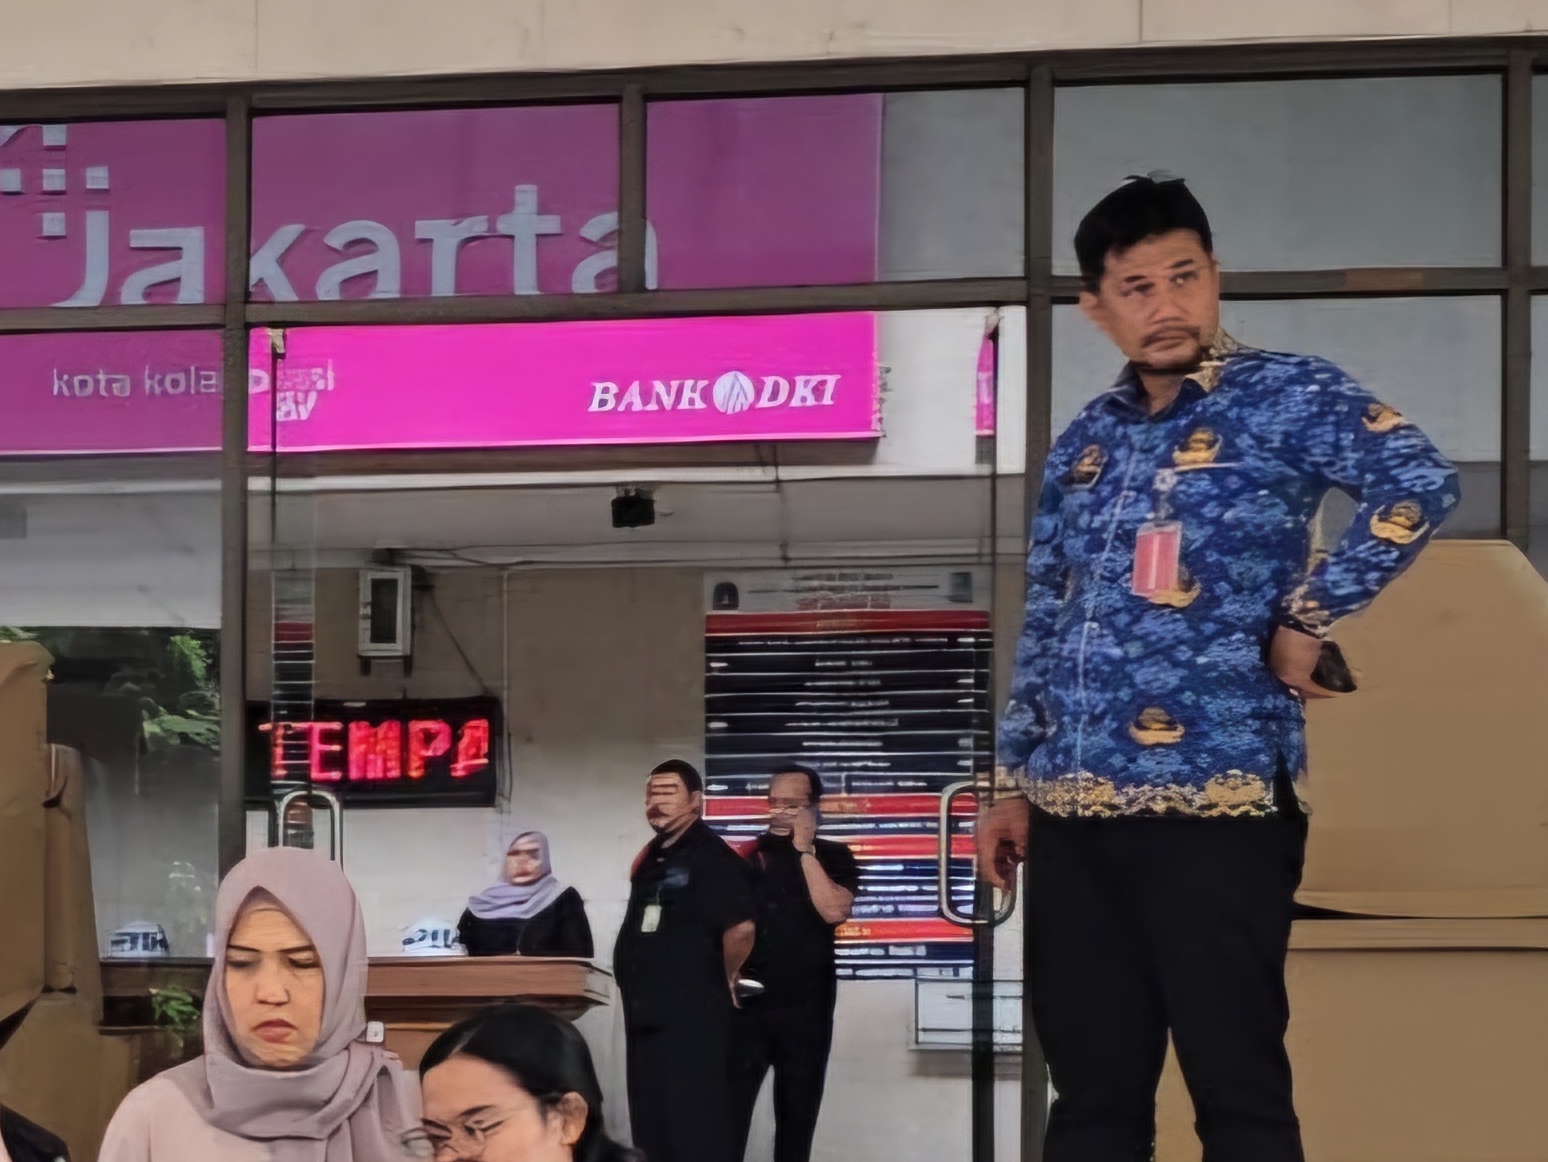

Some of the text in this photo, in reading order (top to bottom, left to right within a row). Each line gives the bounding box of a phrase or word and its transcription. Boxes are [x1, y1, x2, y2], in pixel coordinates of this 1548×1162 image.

[52, 367, 131, 398] kota
[587, 374, 842, 412] BANK DKI
